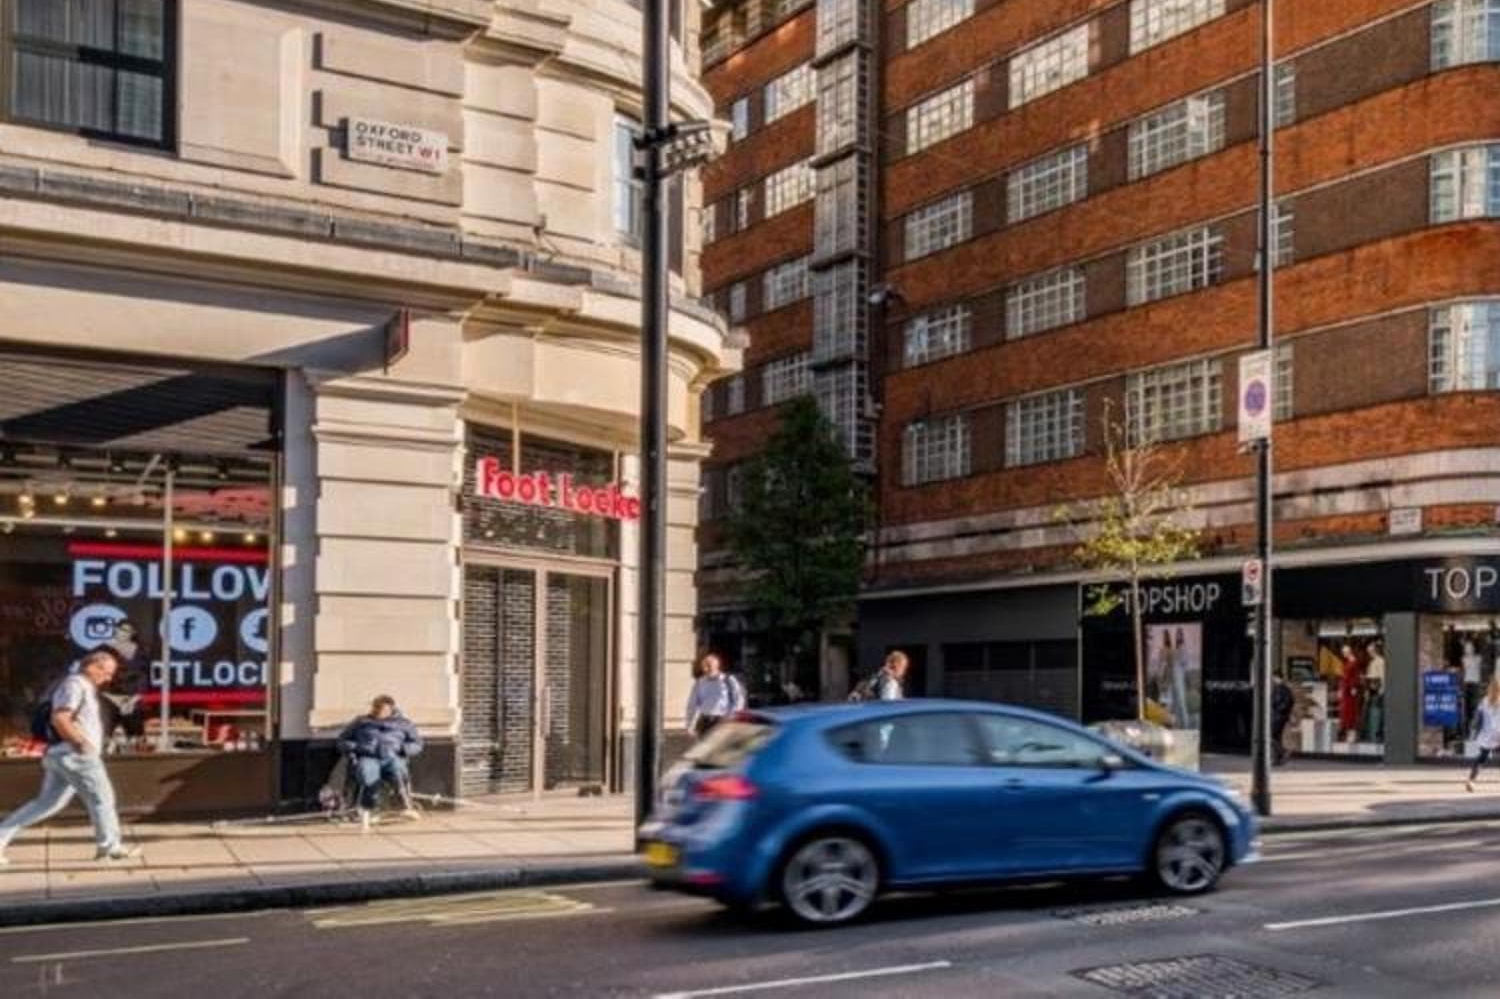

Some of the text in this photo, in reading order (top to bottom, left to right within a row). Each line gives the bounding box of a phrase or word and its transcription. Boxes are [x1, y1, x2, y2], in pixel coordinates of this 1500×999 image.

[355, 122, 421, 143] OXFORD
[357, 135, 413, 154] STREET
[476, 457, 641, 520] Foot Locke
[1121, 583, 1220, 614] TOPSHOP
